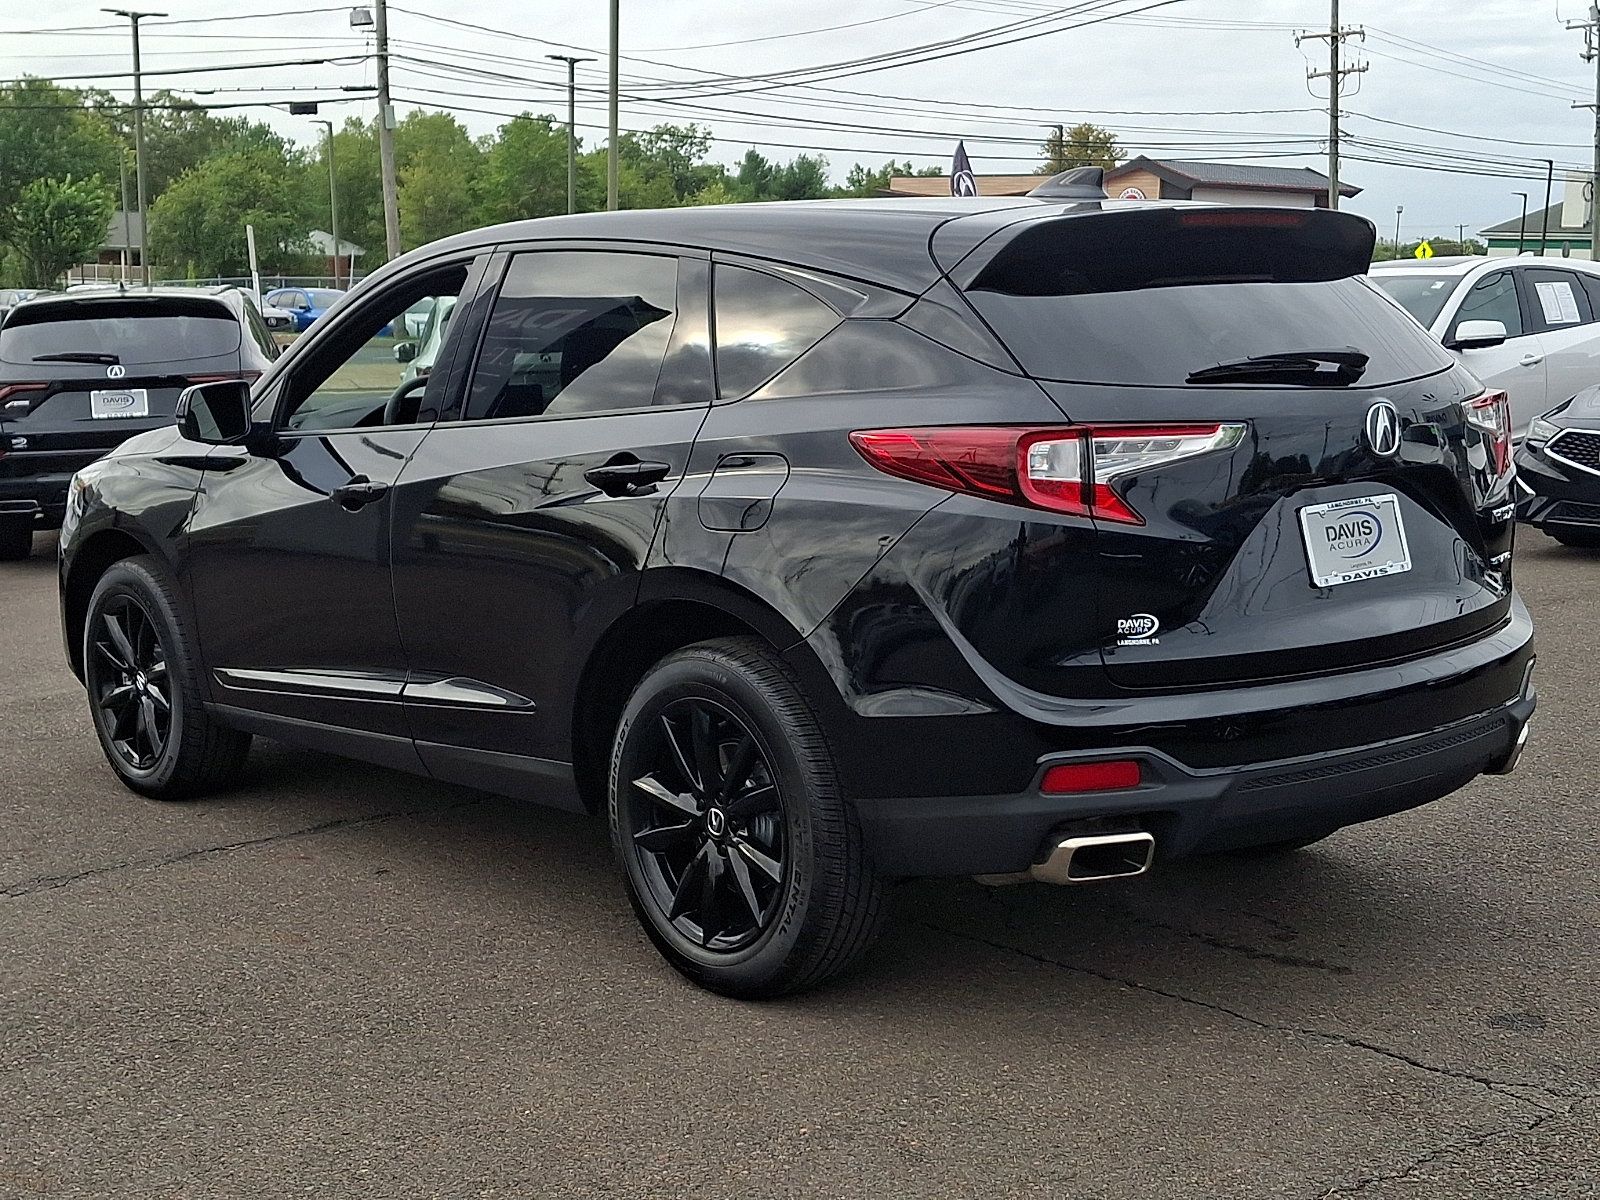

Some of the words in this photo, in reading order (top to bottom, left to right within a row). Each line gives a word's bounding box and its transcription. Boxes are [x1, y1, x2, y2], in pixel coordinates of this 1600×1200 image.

[1325, 519, 1373, 542] DAVIS
[1329, 537, 1371, 552] ACURA
[1342, 567, 1388, 582] DAVIS
[1117, 618, 1152, 628] DAVIS
